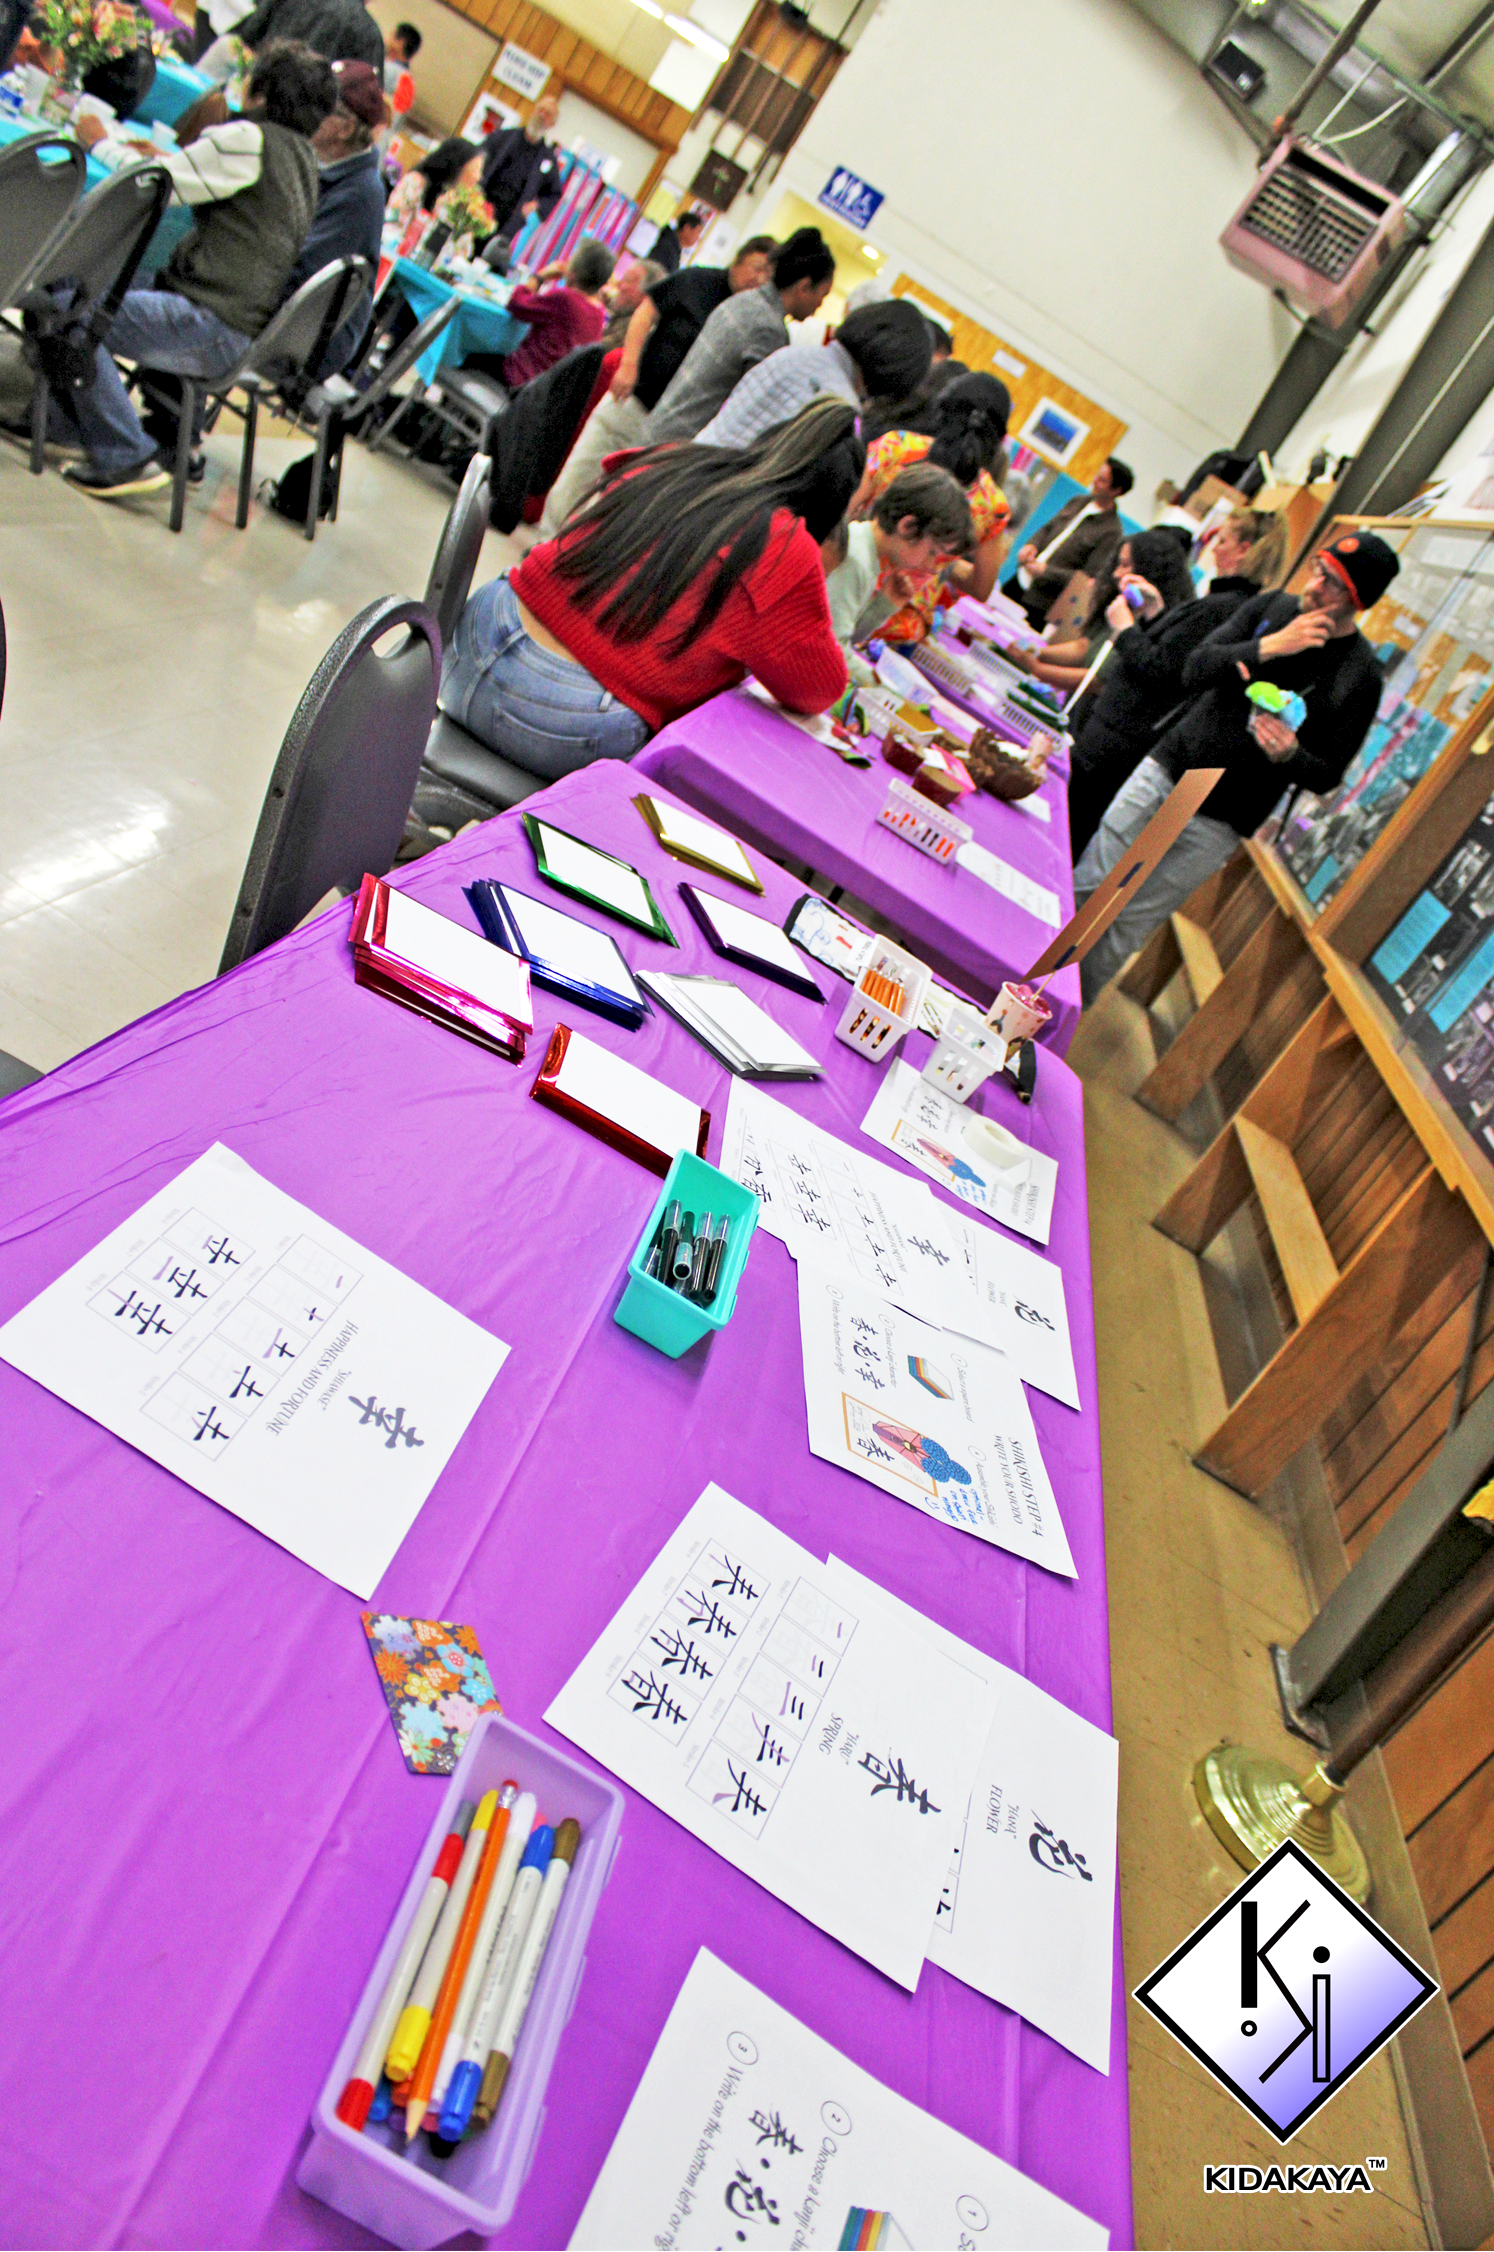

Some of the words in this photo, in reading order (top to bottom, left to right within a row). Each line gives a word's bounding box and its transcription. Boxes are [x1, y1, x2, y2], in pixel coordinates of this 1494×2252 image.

[317, 1319, 359, 1370] HAPPINESS
[301, 1366, 323, 1390] AND
[265, 1387, 309, 1436] FORTUNE
[348, 1395, 425, 1449] 幸
[993, 1434, 1008, 1463] WRITE
[1000, 1462, 1014, 1489] YOUR
[1008, 1436, 1034, 1491] SHIKISHI
[1021, 1490, 1042, 1522] STEP
[1005, 1487, 1023, 1525] SHODO
[818, 1712, 844, 1755] SPRING
[857, 1746, 942, 1814] 春
[986, 1784, 1003, 1834] FLOWER
[1029, 1809, 1093, 1882] 花
[718, 2066, 744, 2100] Write
[703, 2117, 722, 2139] the
[711, 2100, 725, 2118] on
[684, 2138, 715, 2188] bottom
[811, 2136, 837, 2185] Choose
[674, 2186, 697, 2216] left
[808, 2184, 819, 2196] a
[668, 2213, 682, 2233] or
[794, 2195, 820, 2235] kanji
